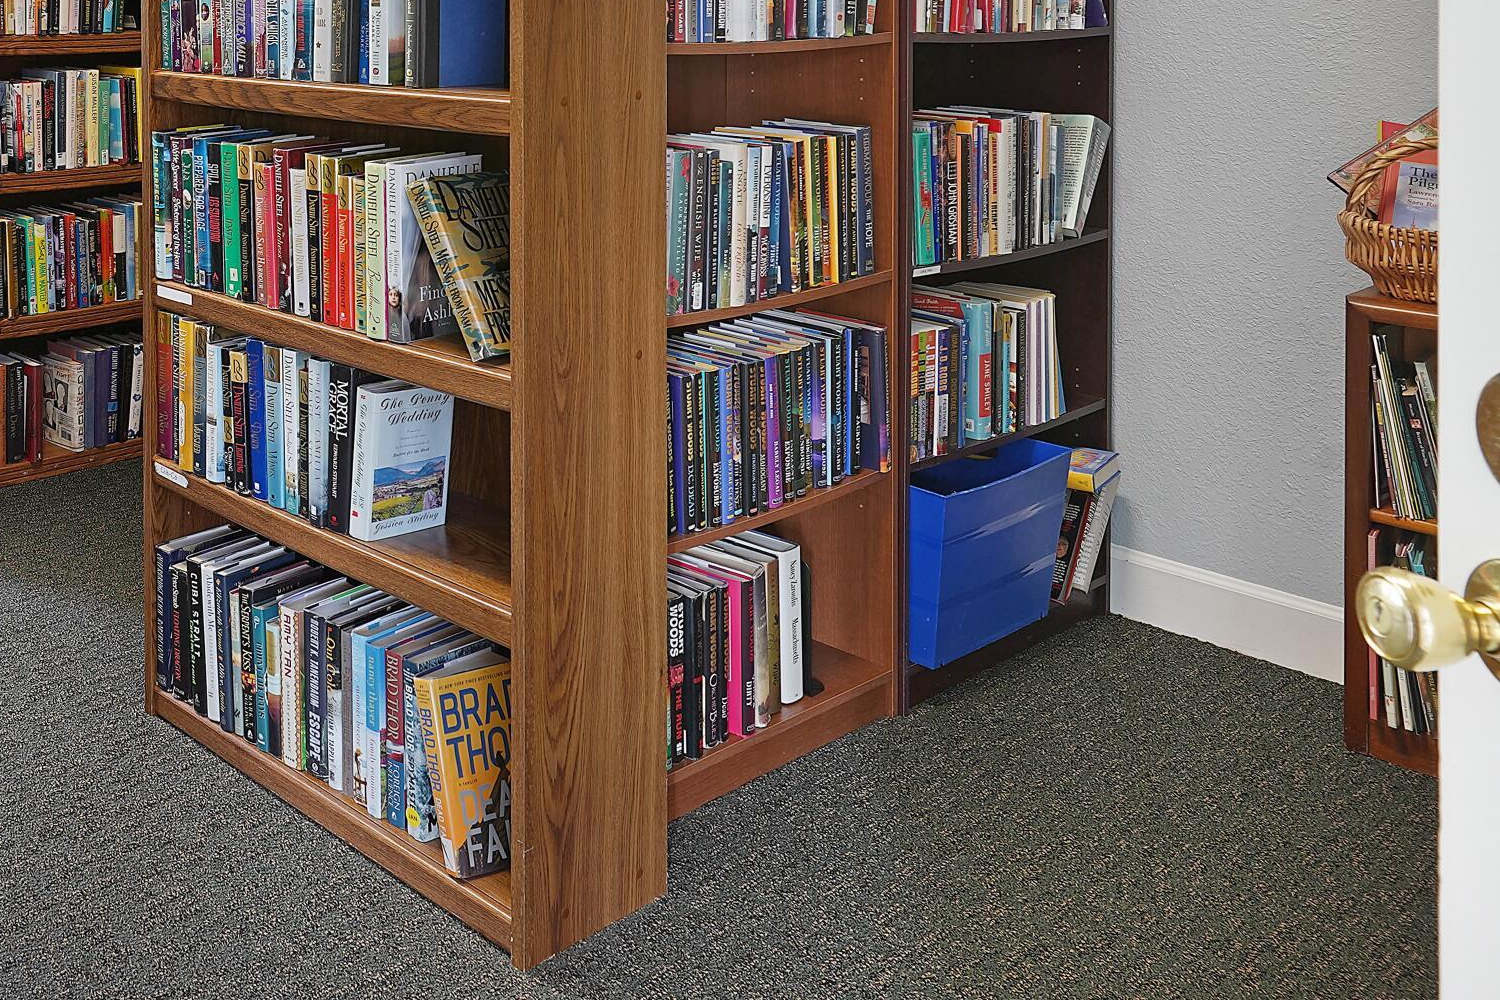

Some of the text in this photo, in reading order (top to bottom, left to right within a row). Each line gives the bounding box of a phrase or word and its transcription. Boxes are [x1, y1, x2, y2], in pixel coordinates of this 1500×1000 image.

[236, 37, 245, 62] SMALL
[194, 155, 205, 231] PREPARED FOR RAGE
[275, 155, 284, 259] DANIELLE STEEL Duchess
[367, 174, 379, 225] DANIELLE
[948, 182, 957, 245] JOHN GRISHAM
[368, 227, 380, 259] STEEL
[694, 179, 703, 262] ENGLISH WIFE
[410, 183, 472, 329] DANIELLE STEEL MESSAGE FROM NAM
[370, 312, 380, 324] 2
[336, 380, 348, 440] MORTAL
[380, 391, 450, 410] The Penny
[388, 408, 442, 425] Wedding
[374, 511, 439, 535] Jessica Stirling
[190, 572, 200, 657] CUBA STRAIT
[242, 606, 250, 646] SERPENT'S
[669, 606, 678, 657] WOODS
[242, 650, 251, 671] KISS
[387, 655, 399, 740] BRAD THOR
[446, 726, 511, 779] THO
[392, 764, 400, 810] FOREIGN
